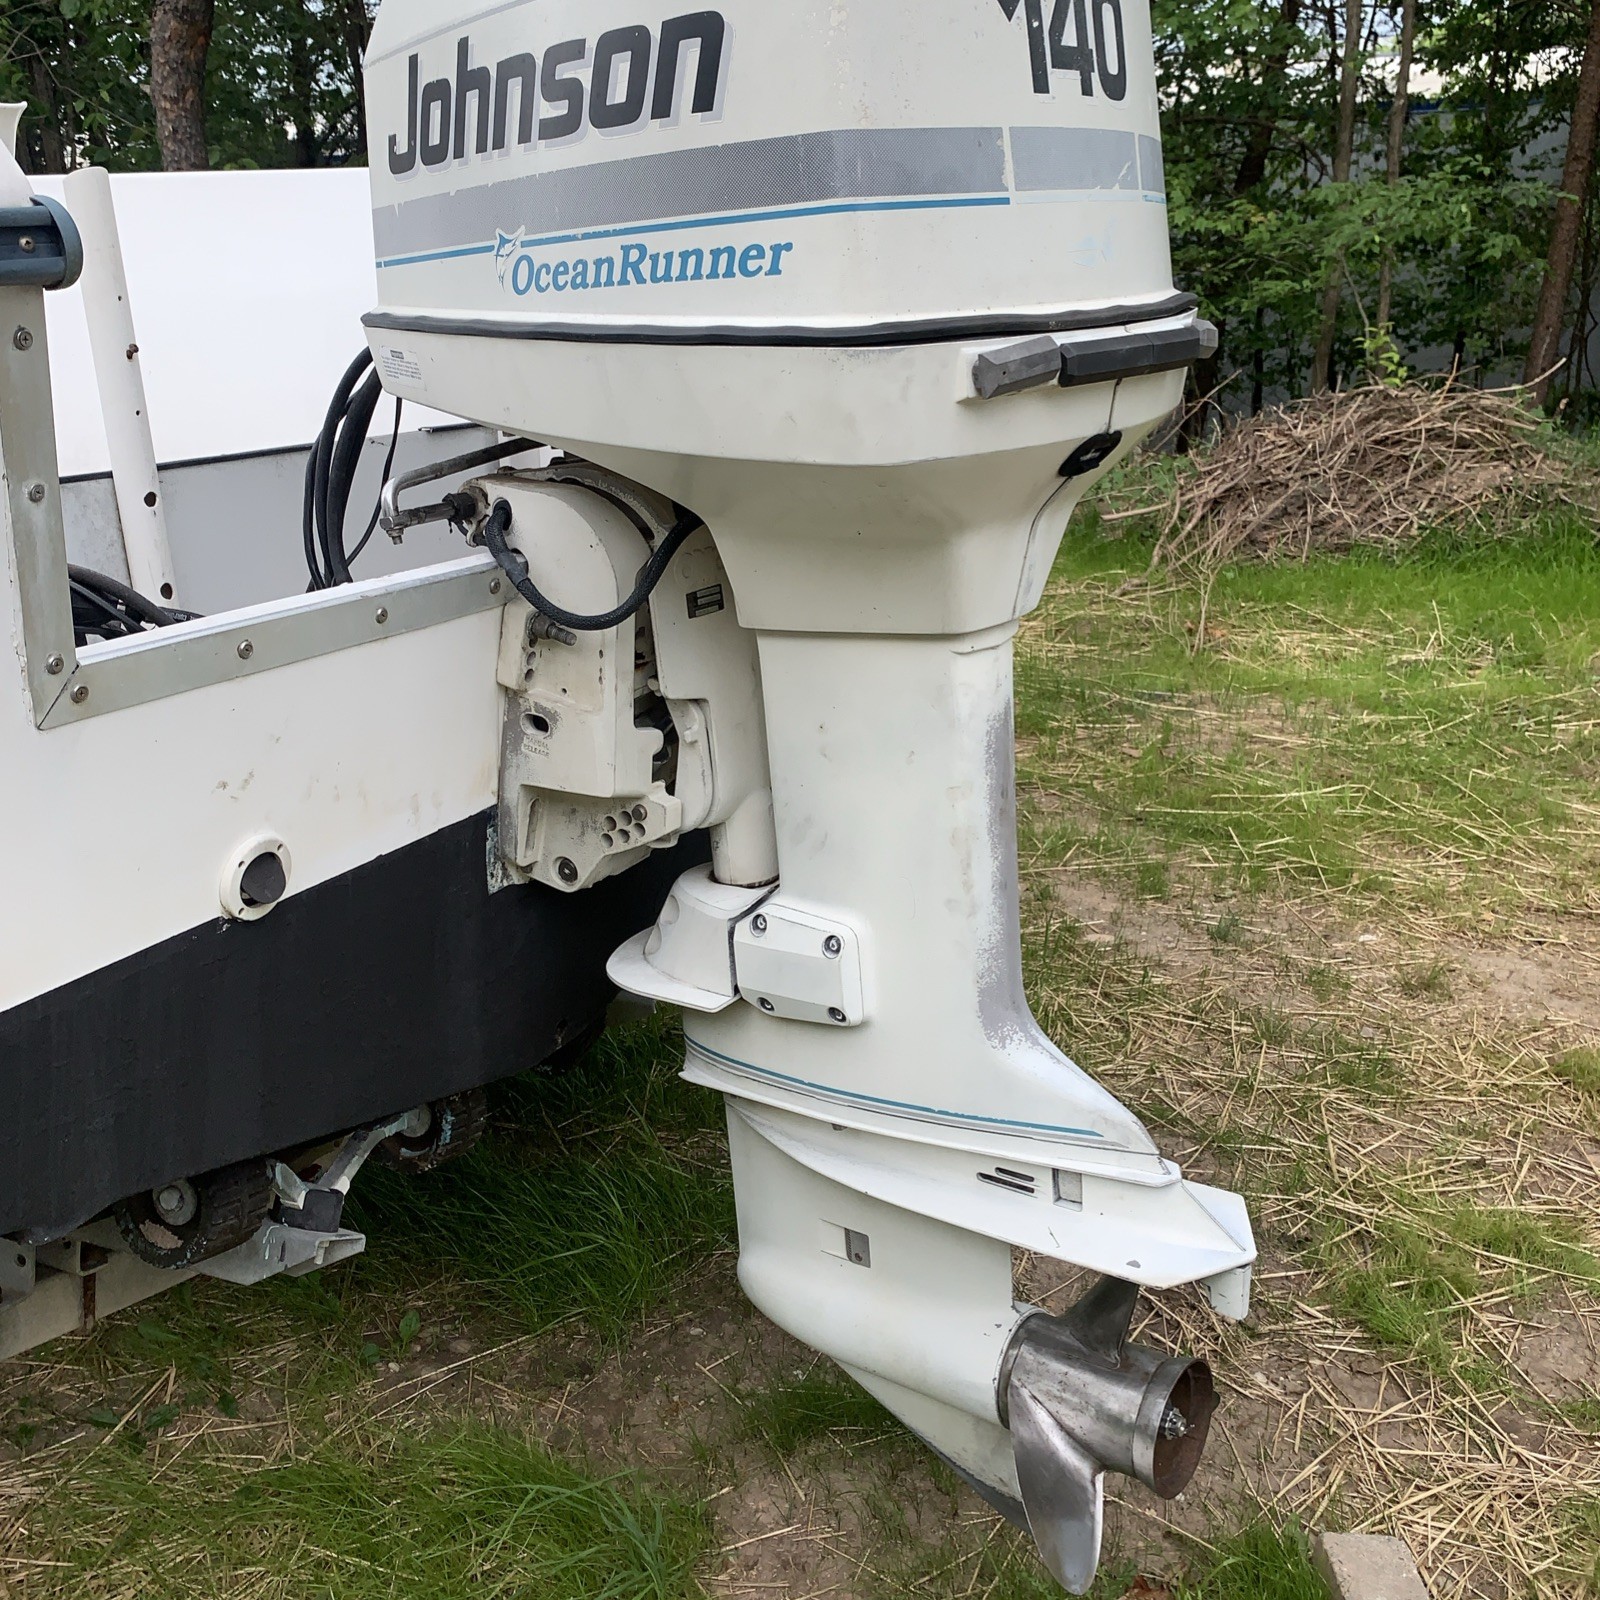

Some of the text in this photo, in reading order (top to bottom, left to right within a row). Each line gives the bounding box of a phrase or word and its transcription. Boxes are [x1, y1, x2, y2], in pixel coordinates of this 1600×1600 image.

[387, 10, 727, 177] Johnson
[1023, 0, 1127, 102] 140
[510, 241, 794, 297] OceanRunner
